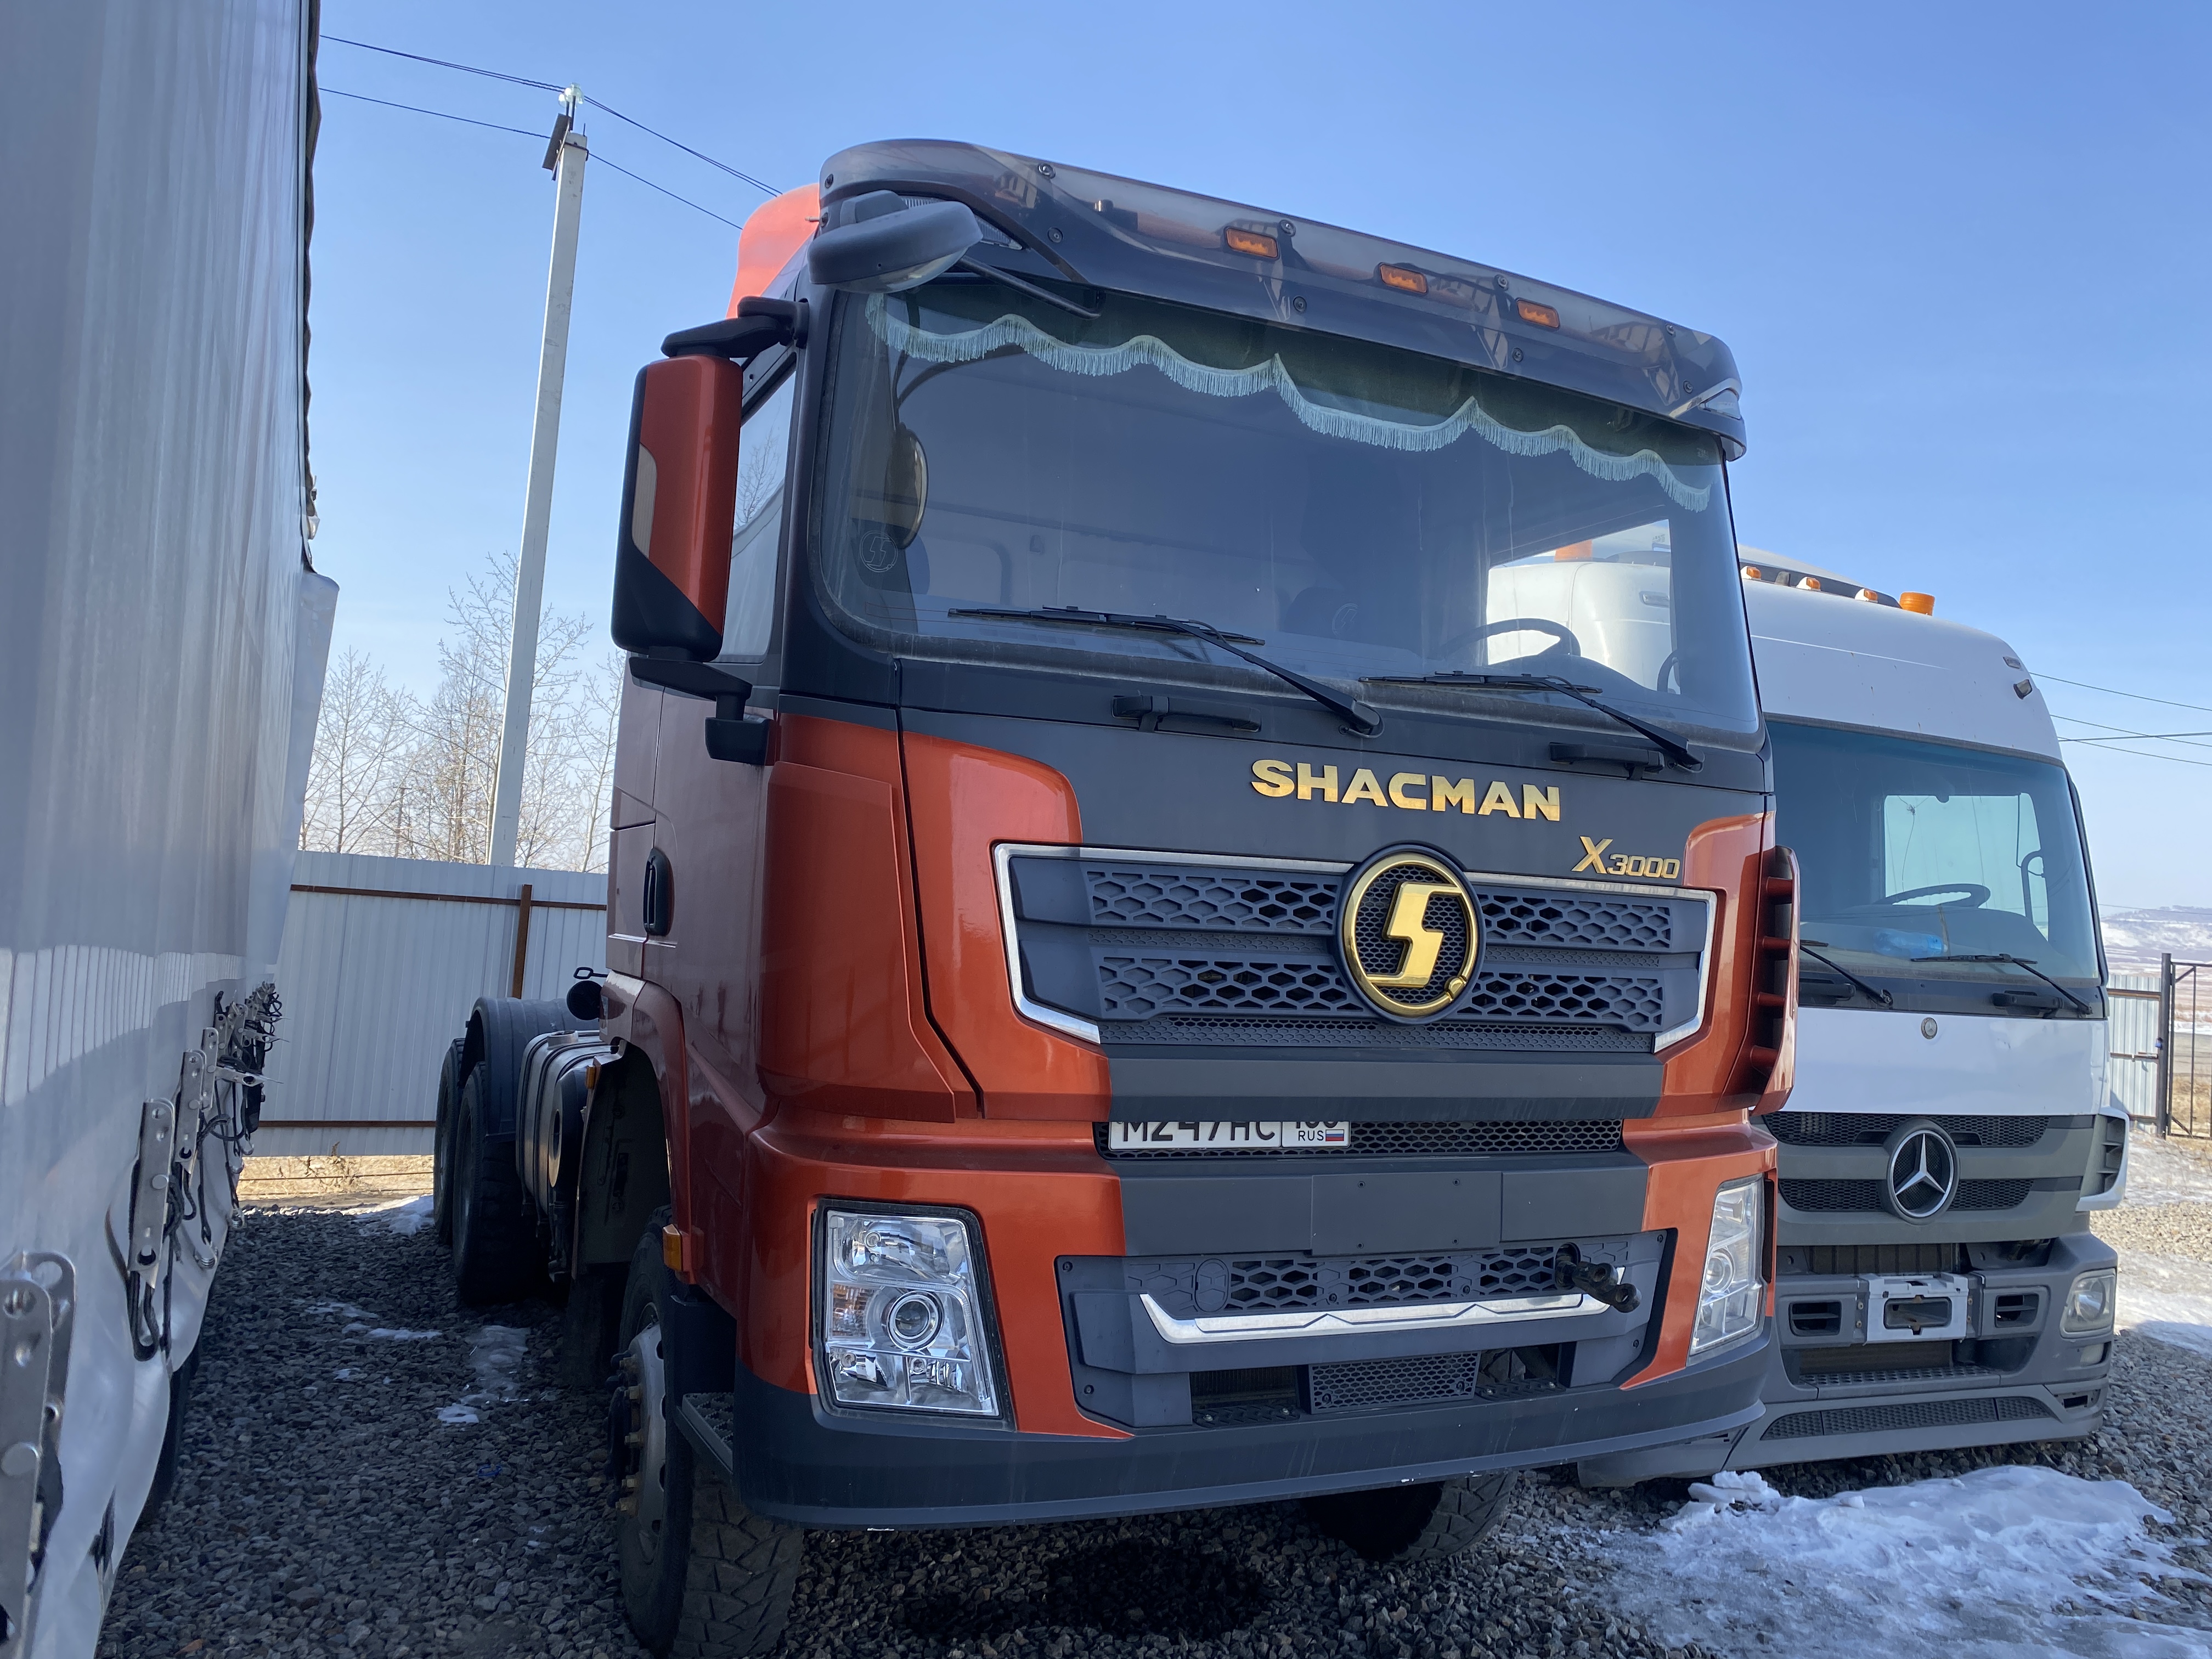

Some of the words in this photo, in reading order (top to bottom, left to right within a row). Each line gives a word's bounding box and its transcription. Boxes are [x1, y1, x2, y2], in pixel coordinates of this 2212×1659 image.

[1251, 759, 1561, 822] SHACMAN
[1571, 836, 1681, 879] X3000
[1298, 1130, 1324, 1142] RUS
